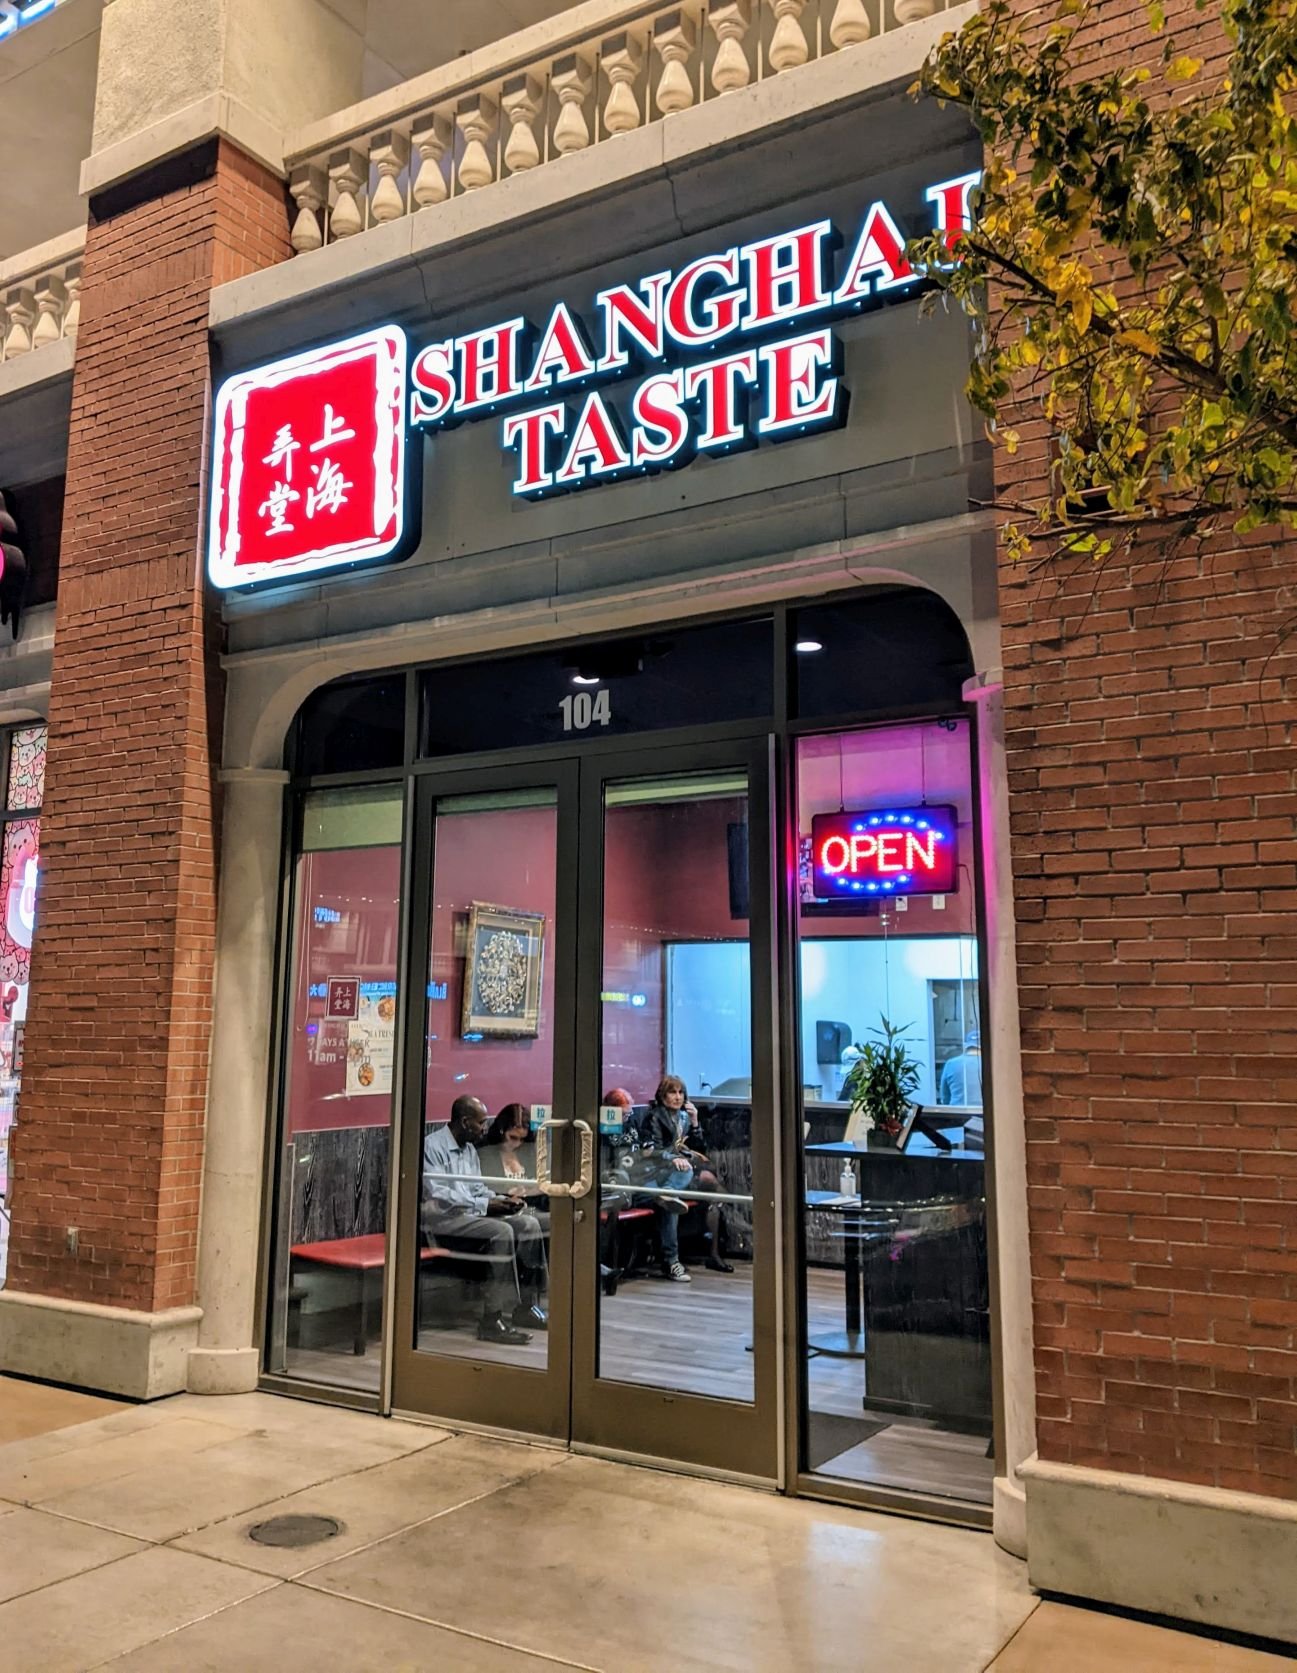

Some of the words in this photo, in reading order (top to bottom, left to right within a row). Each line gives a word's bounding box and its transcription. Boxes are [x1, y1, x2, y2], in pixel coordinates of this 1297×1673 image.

[411, 170, 982, 425] SHANGHAI
[503, 328, 838, 494] TASTE
[306, 403, 356, 519] 上海
[558, 689, 612, 731] 104
[821, 830, 935, 874] OPEN
[307, 1049, 337, 1063] 11am
